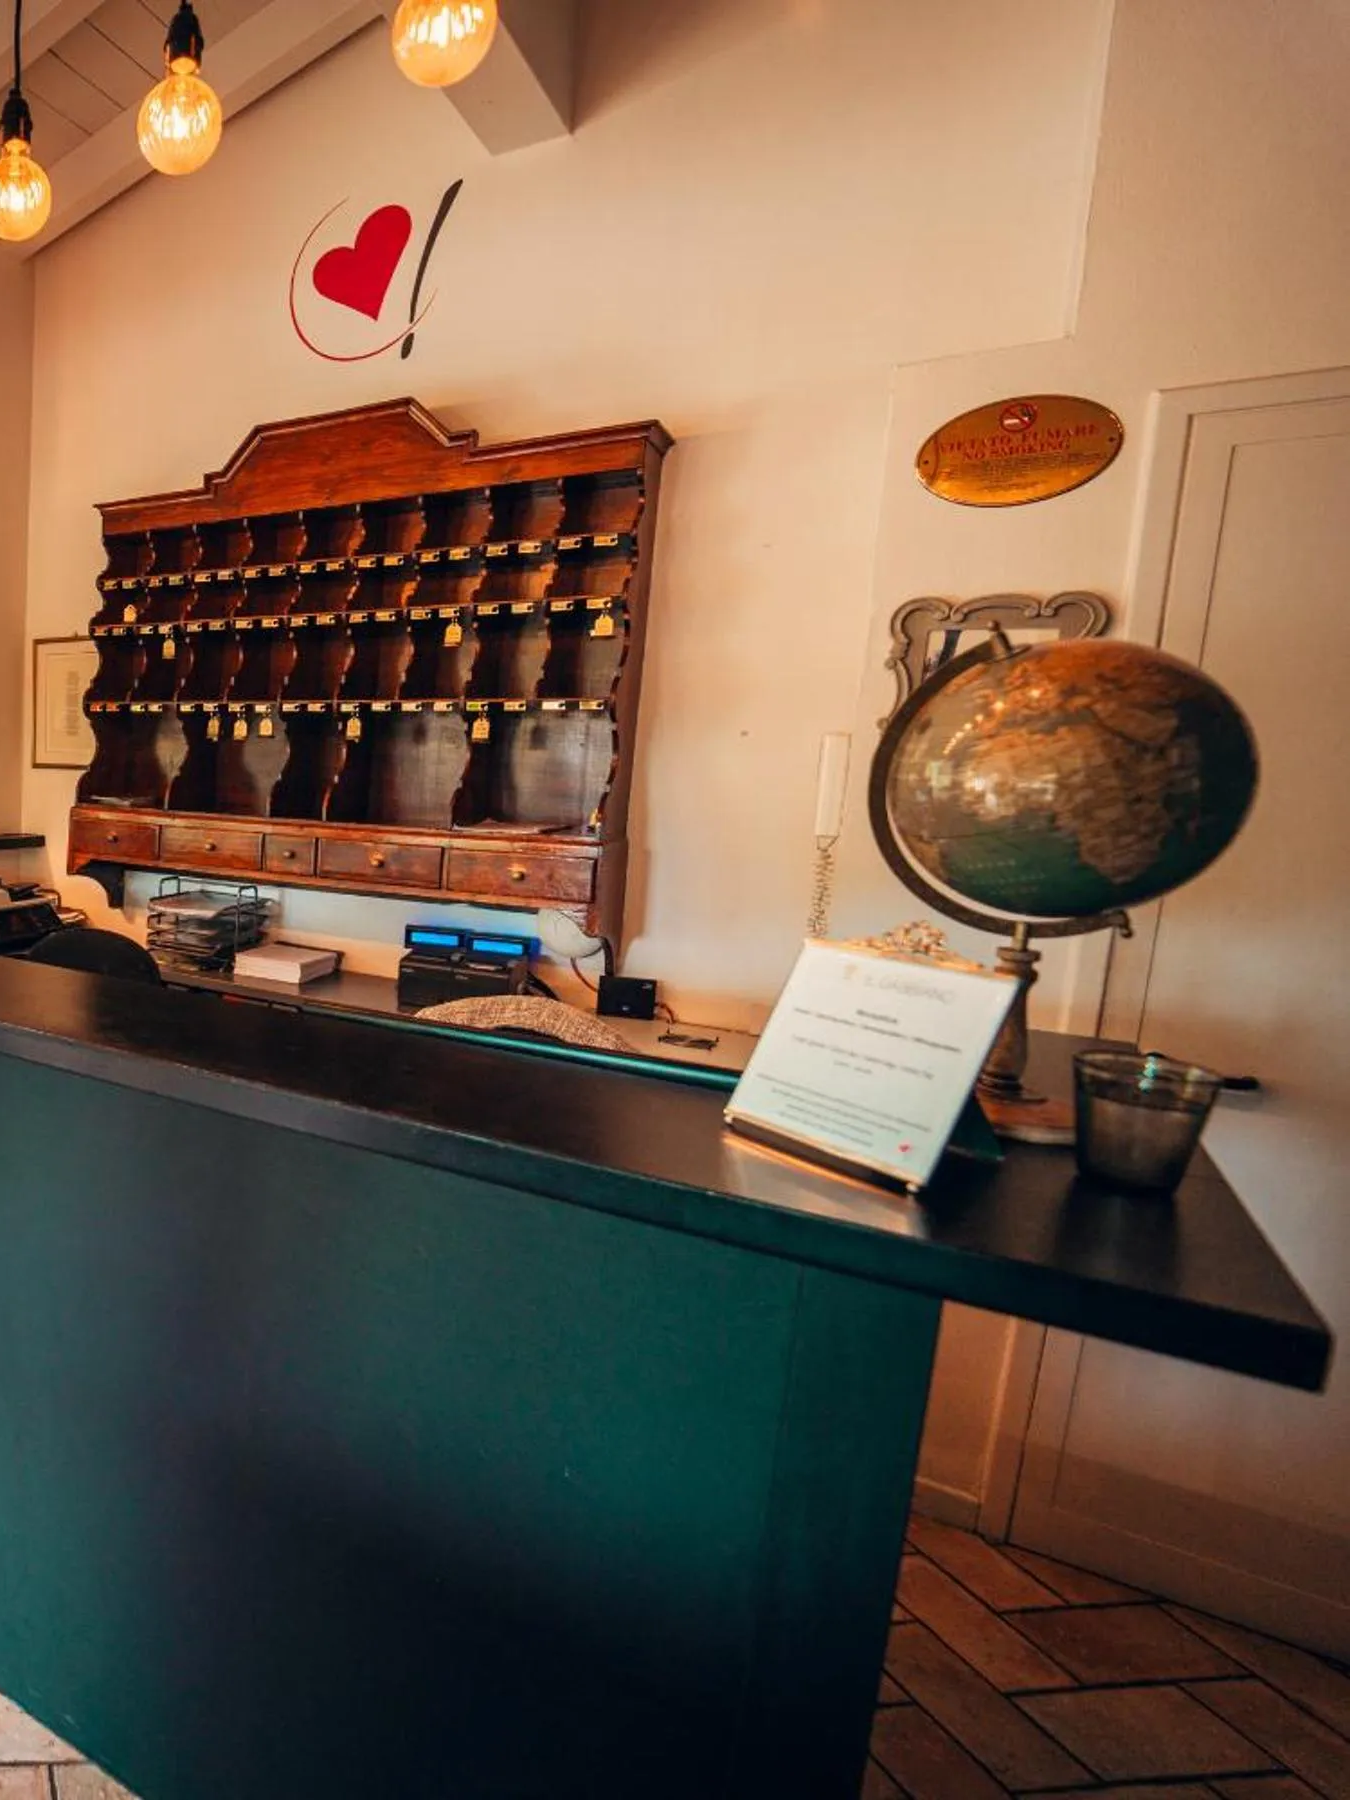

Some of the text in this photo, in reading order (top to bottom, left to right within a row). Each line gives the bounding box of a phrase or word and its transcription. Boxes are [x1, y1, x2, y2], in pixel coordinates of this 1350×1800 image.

[940, 435, 1012, 453] VIETATO
[962, 440, 1071, 461] NO SMOKING
